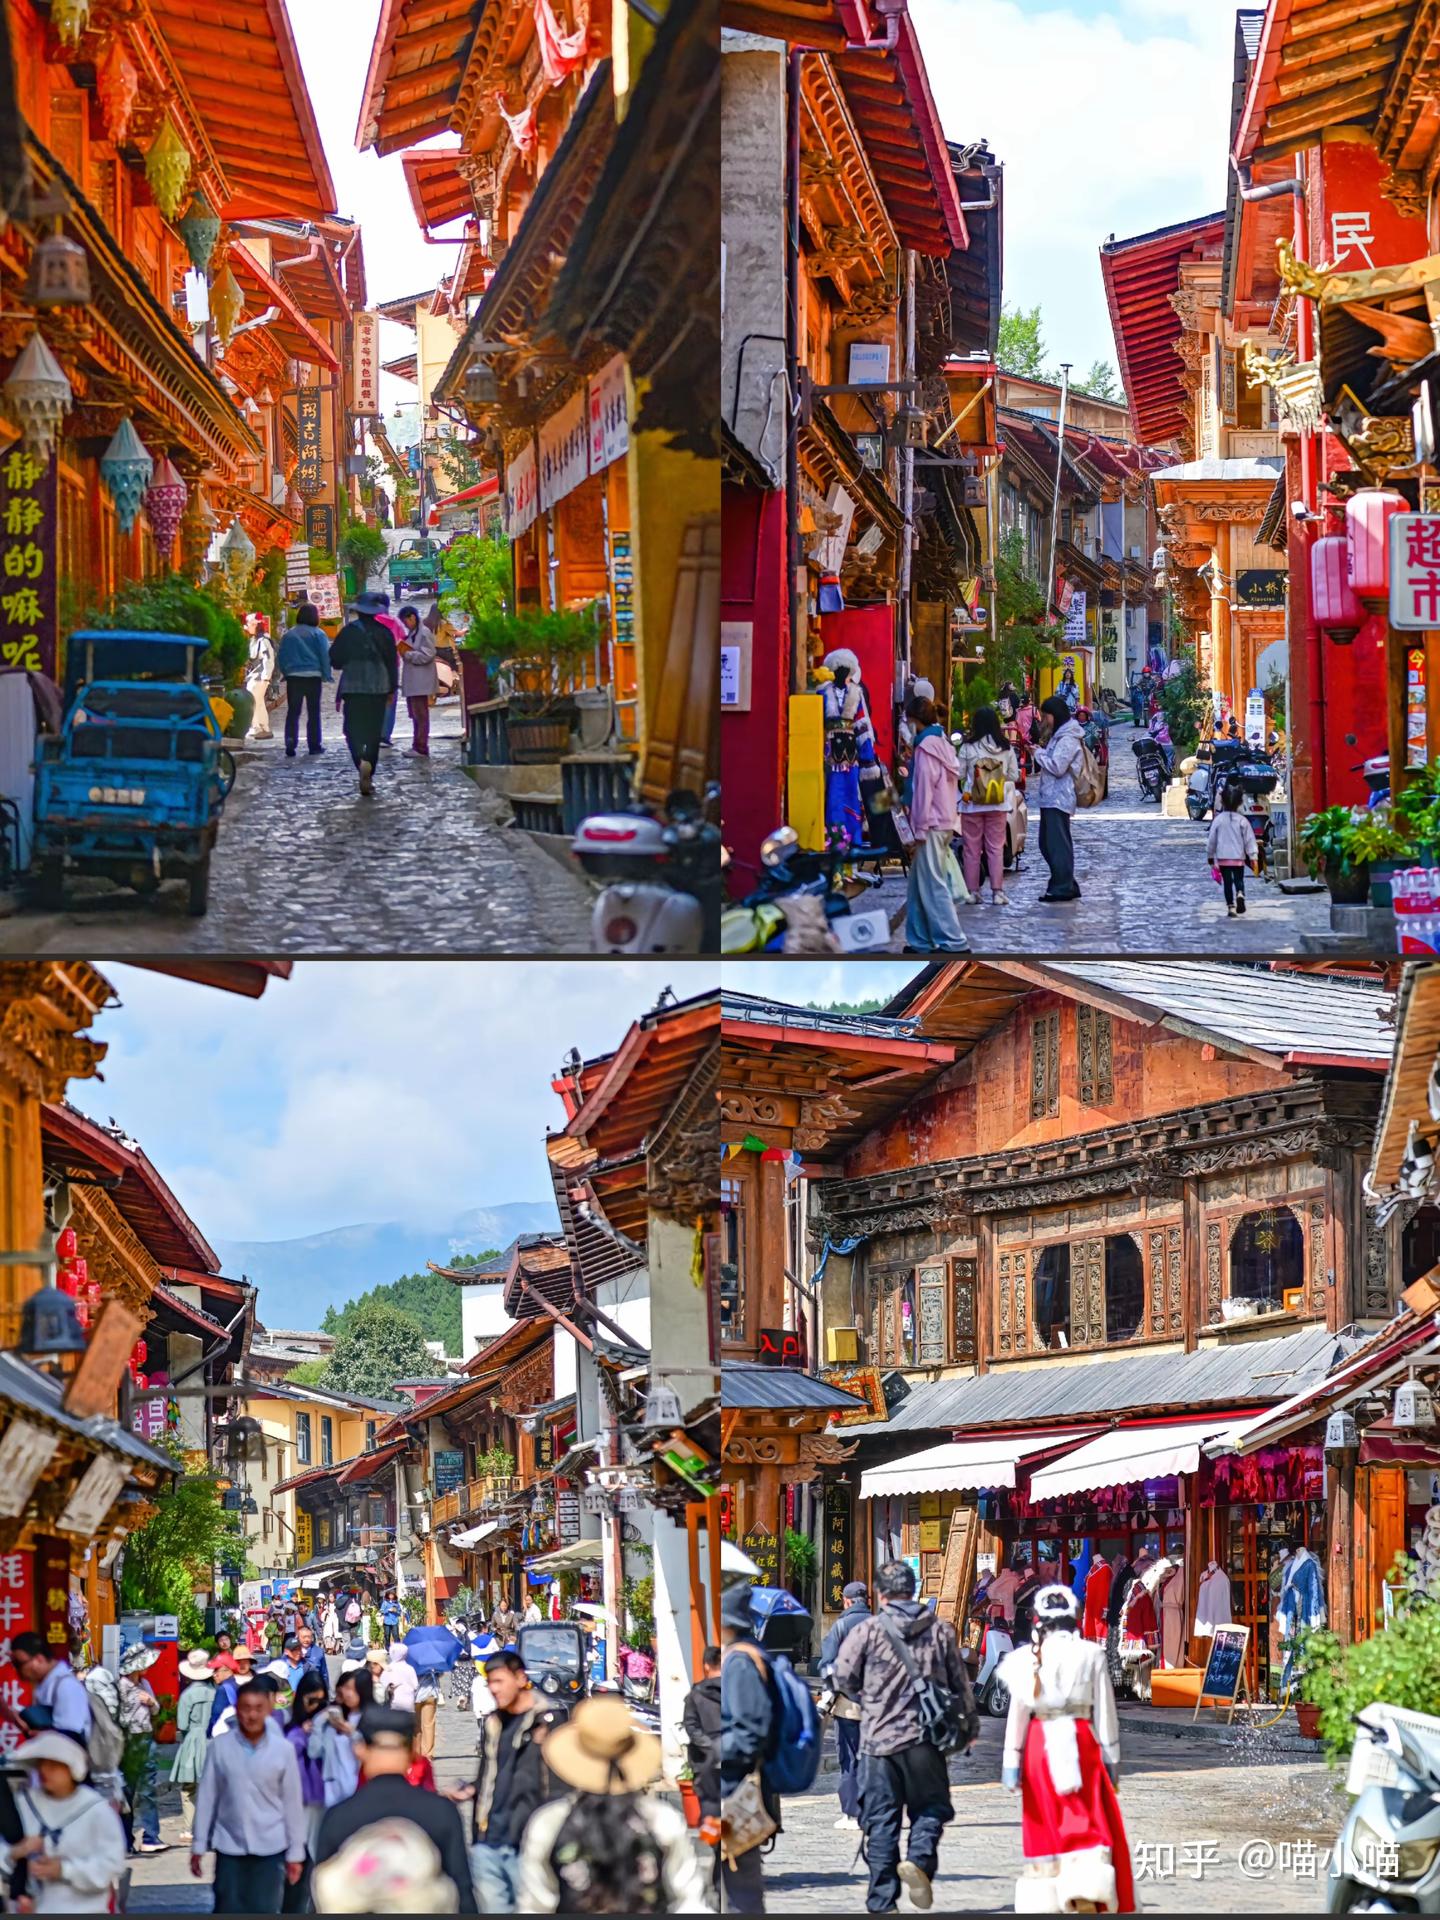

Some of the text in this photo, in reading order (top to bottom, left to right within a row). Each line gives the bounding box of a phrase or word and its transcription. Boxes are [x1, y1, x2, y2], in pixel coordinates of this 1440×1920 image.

[301, 402, 317, 480] 玛吉阿妈
[2, 451, 44, 671] 静静的嘛呢
[1406, 518, 1440, 622] 超市
[744, 1536, 777, 1549] 牦牛肉
[831, 1517, 845, 1602] 阿妈藏餐
